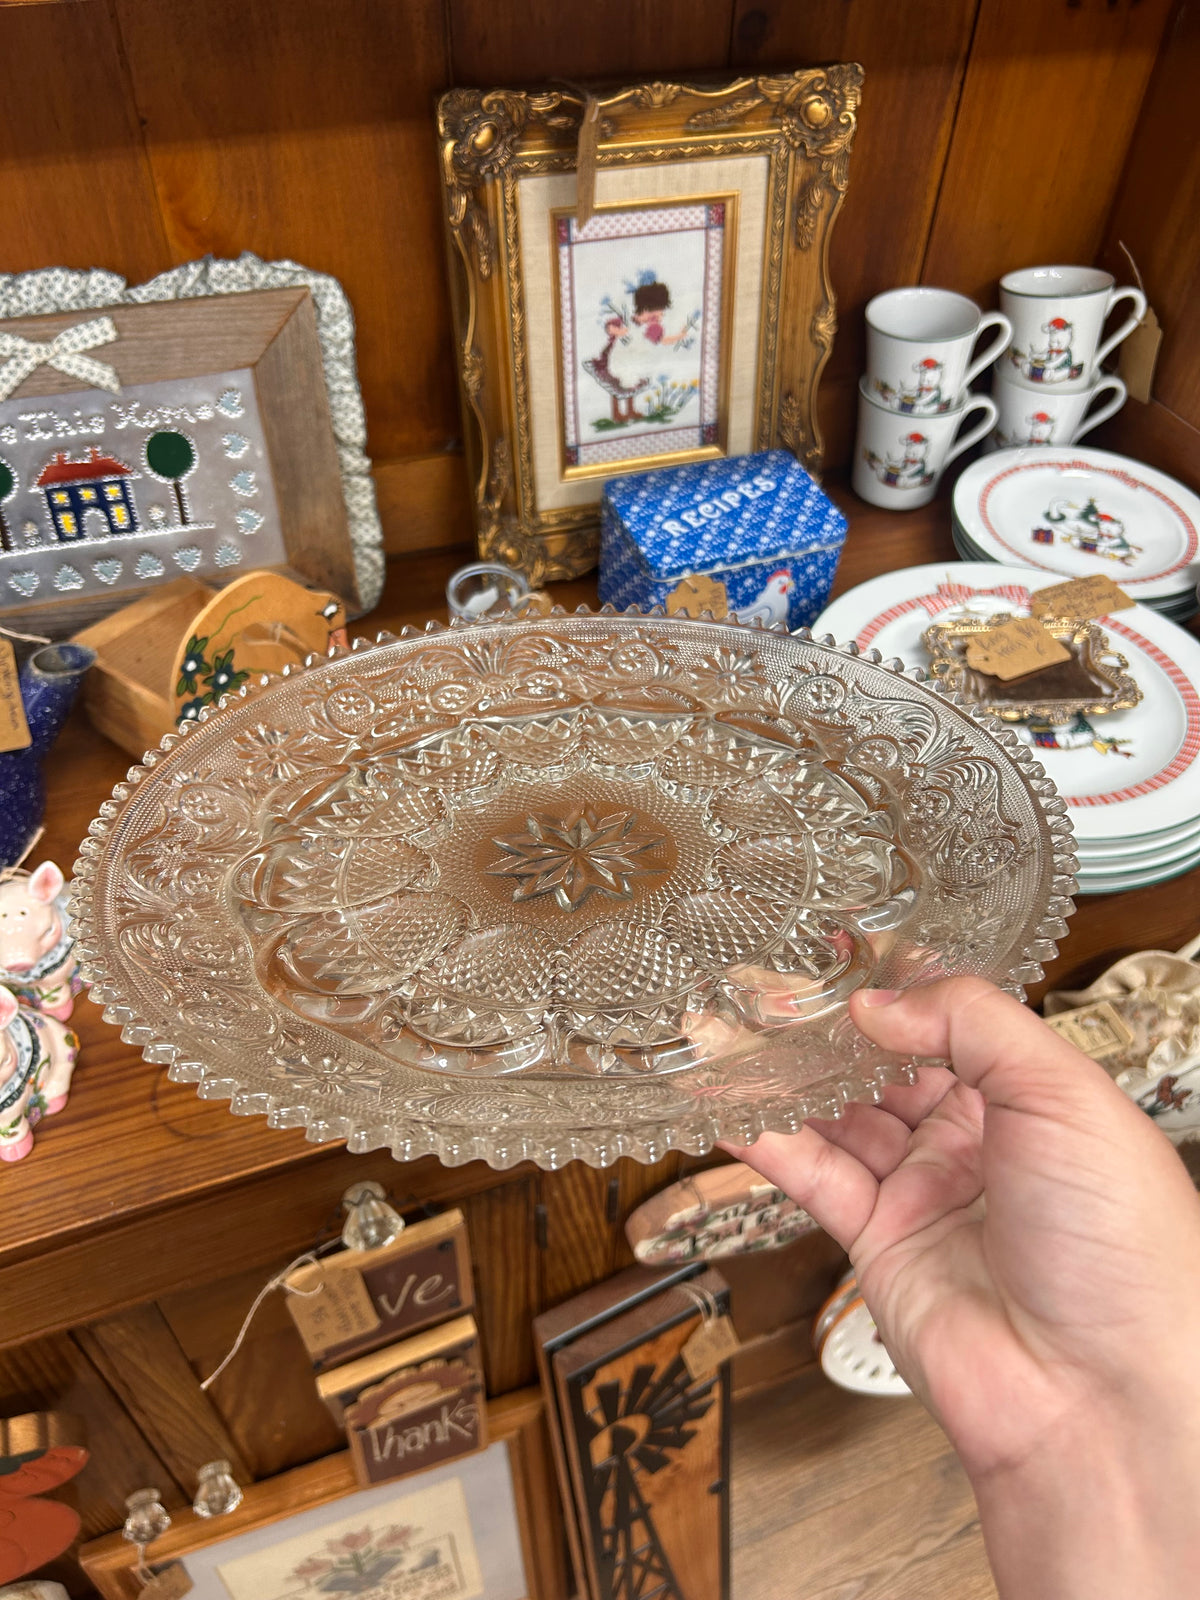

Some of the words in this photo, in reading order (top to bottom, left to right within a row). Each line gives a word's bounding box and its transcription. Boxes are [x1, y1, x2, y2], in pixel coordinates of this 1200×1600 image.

[18, 409, 105, 441] This
[661, 475, 777, 537] RECIPES
[378, 1274, 456, 1316] ve
